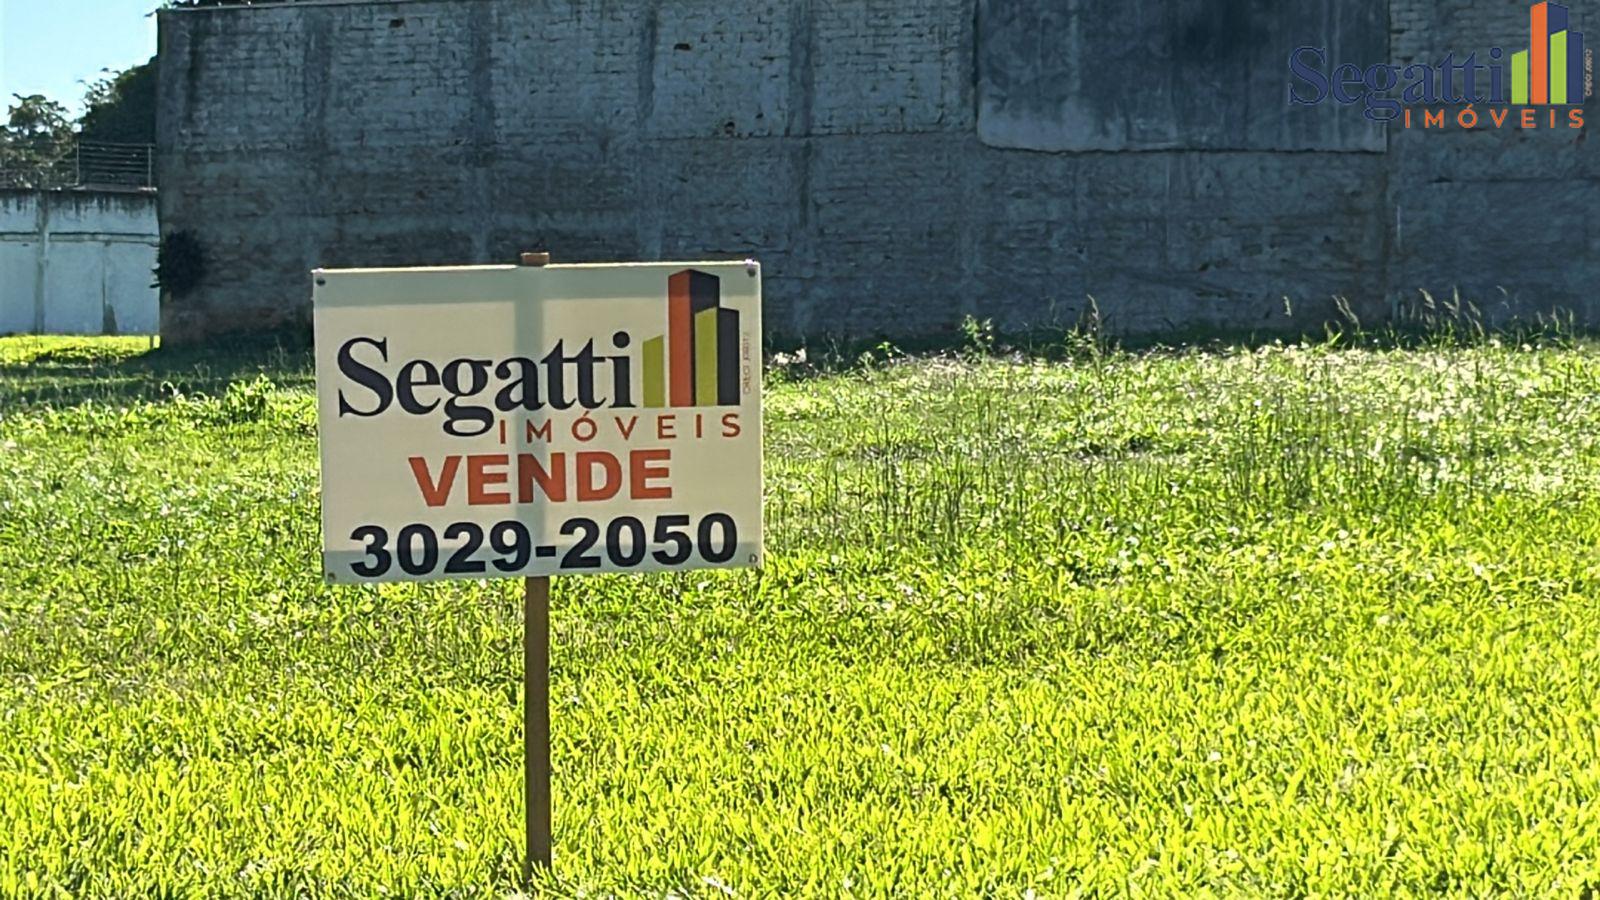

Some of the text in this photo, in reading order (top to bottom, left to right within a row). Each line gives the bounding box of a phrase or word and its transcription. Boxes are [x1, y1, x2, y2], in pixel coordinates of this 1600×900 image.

[337, 331, 637, 437] Segatti
[499, 410, 742, 445] IMÓVEIS
[408, 449, 673, 507] VENDE
[349, 512, 738, 577] 3029-2050
